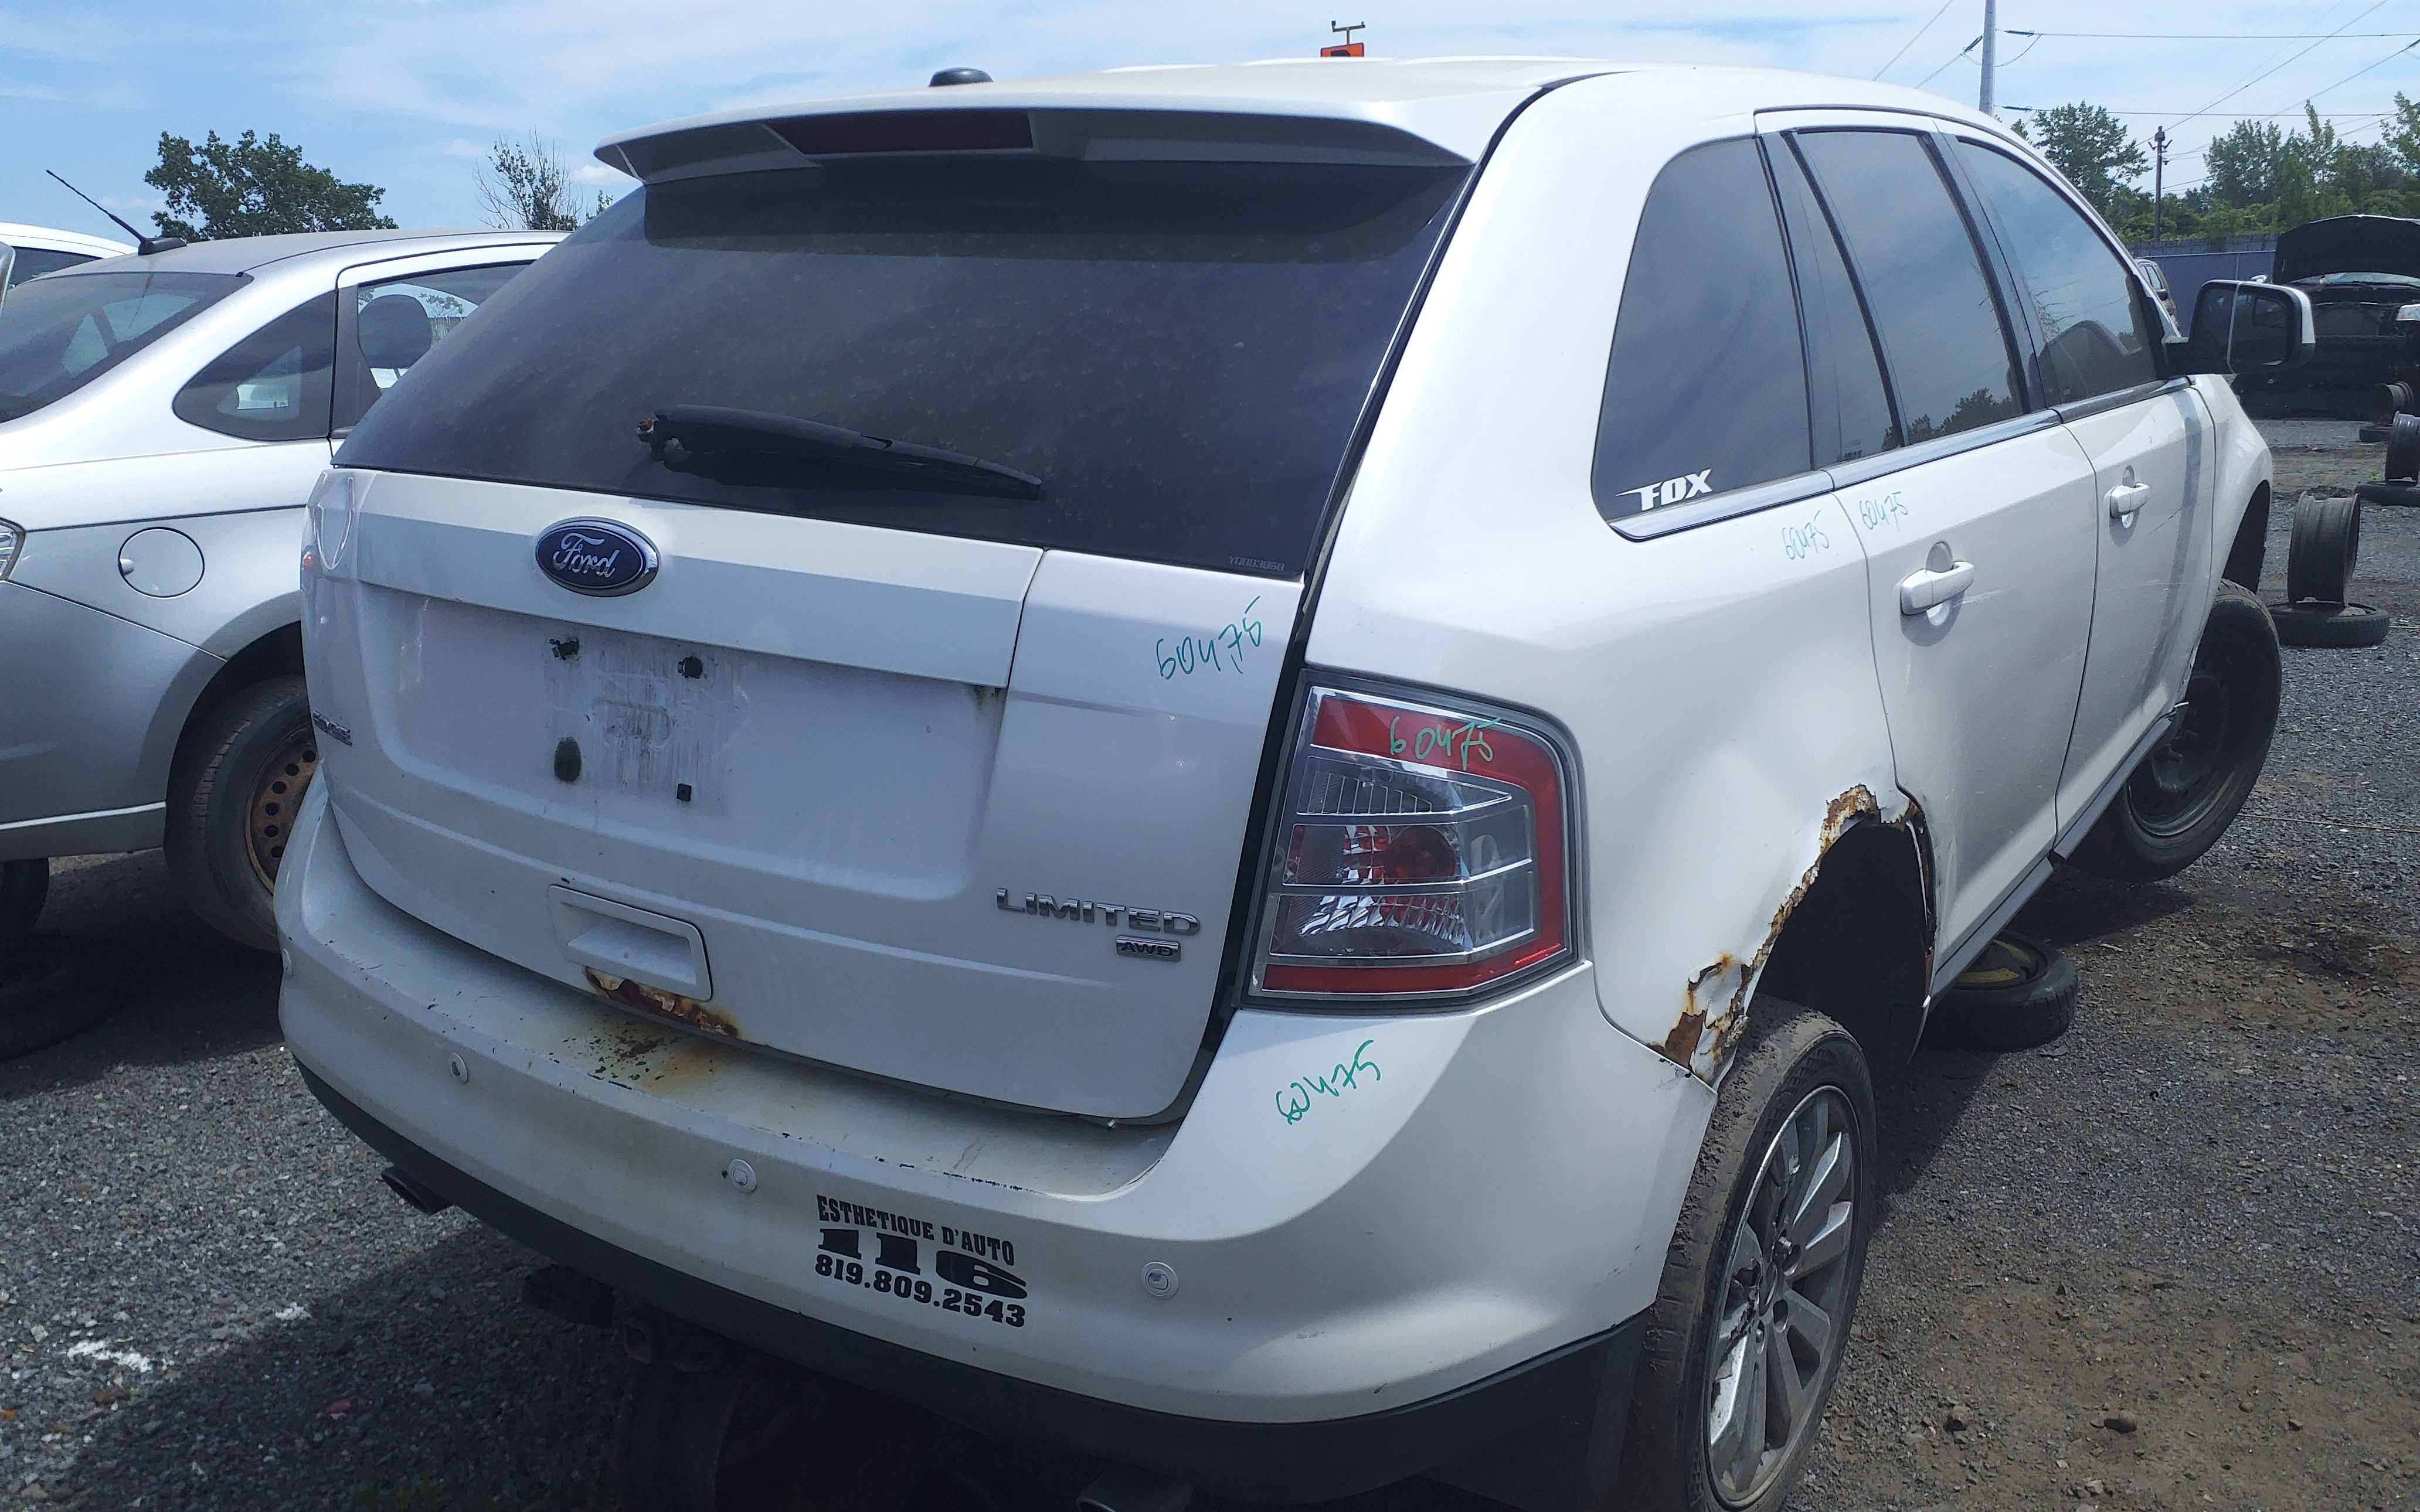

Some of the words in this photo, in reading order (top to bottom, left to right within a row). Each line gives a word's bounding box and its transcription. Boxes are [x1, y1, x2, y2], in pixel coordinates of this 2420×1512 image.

[1616, 469, 1713, 511] FOX
[1860, 491, 1908, 532] 60475
[553, 532, 620, 578] Ford
[1782, 510, 1829, 560] 60475
[1156, 595, 1262, 679] 60475
[1389, 717, 1501, 771] 60475
[997, 887, 1201, 936] LIMITED
[1120, 941, 1173, 957] AWD
[817, 1195, 934, 1241] ESTHETIQUE
[942, 1226, 1014, 1266] D'AUTO
[818, 1228, 1028, 1299] 116
[815, 1254, 1026, 1327] 819.809.2543
